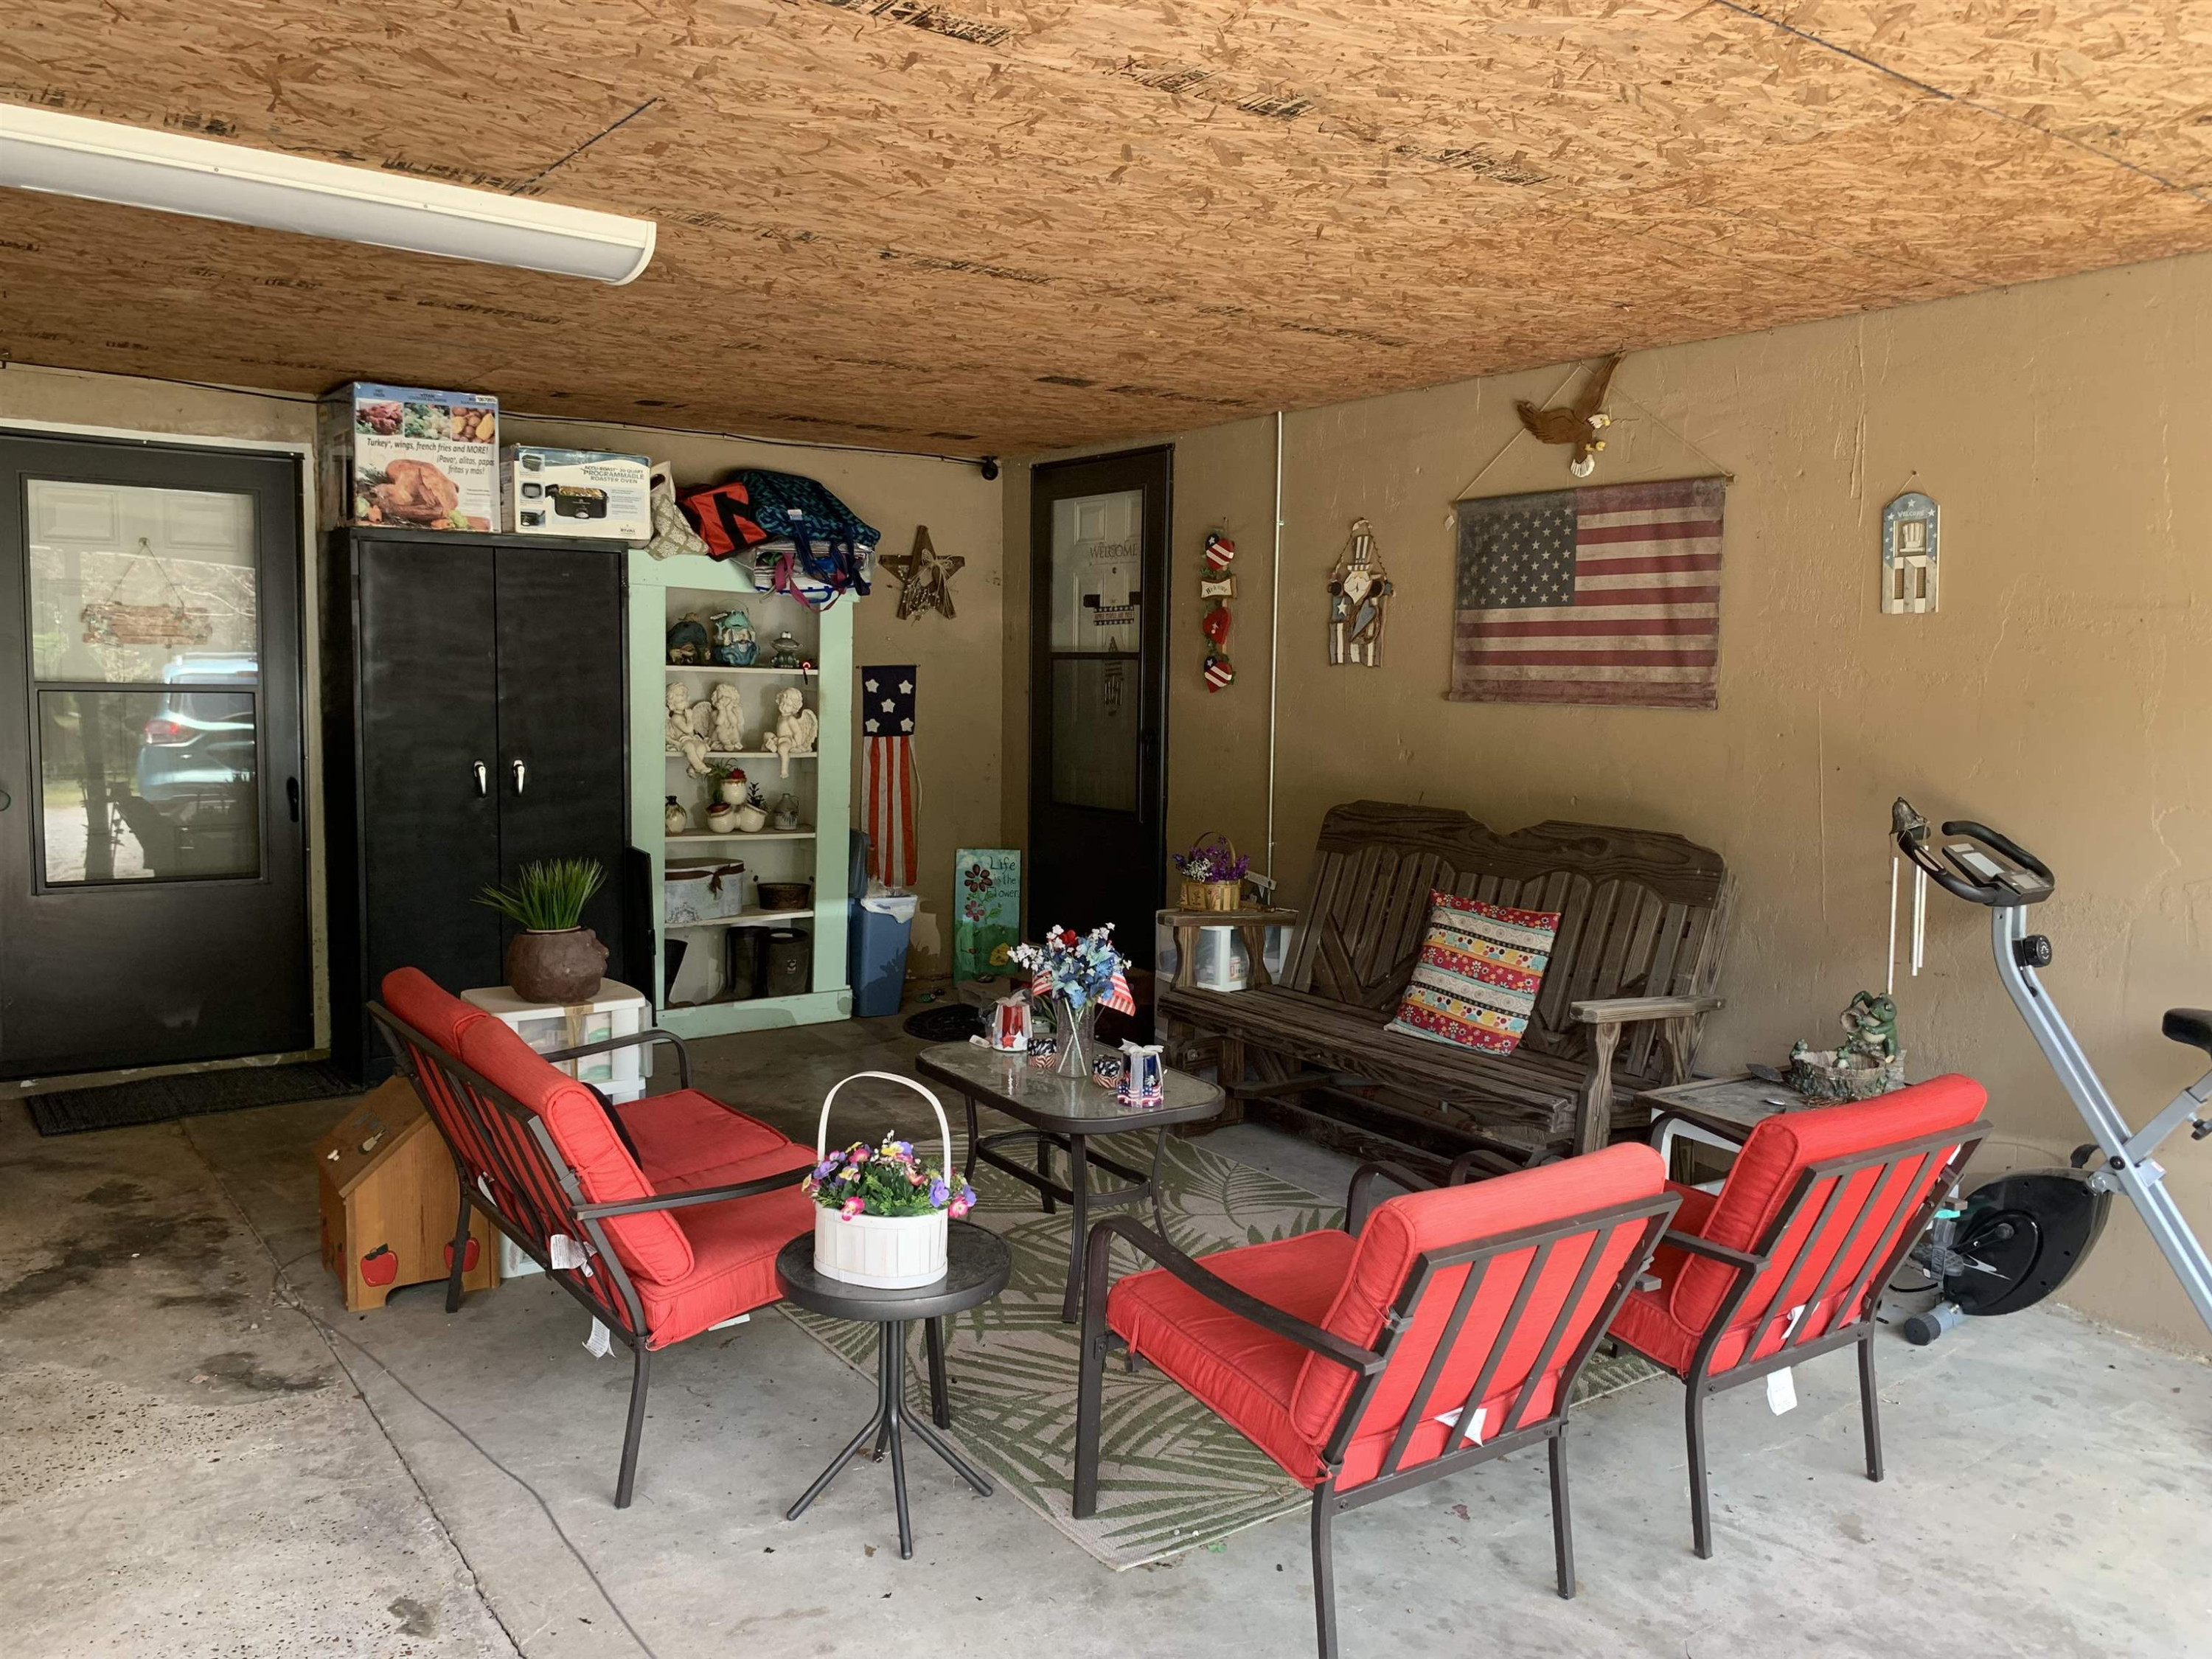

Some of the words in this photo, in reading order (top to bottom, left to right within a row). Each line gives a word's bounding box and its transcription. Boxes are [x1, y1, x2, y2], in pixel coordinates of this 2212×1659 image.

[416, 442, 437, 451] french
[437, 442, 452, 453] fries
[453, 445, 465, 453] and
[467, 445, 488, 454] MORE!
[583, 470, 644, 479] PROGRAMMABLE
[1090, 543, 1138, 559] WELCOME
[990, 856, 1015, 875] Life
[993, 873, 1002, 883] is
[1003, 874, 1017, 885] the
